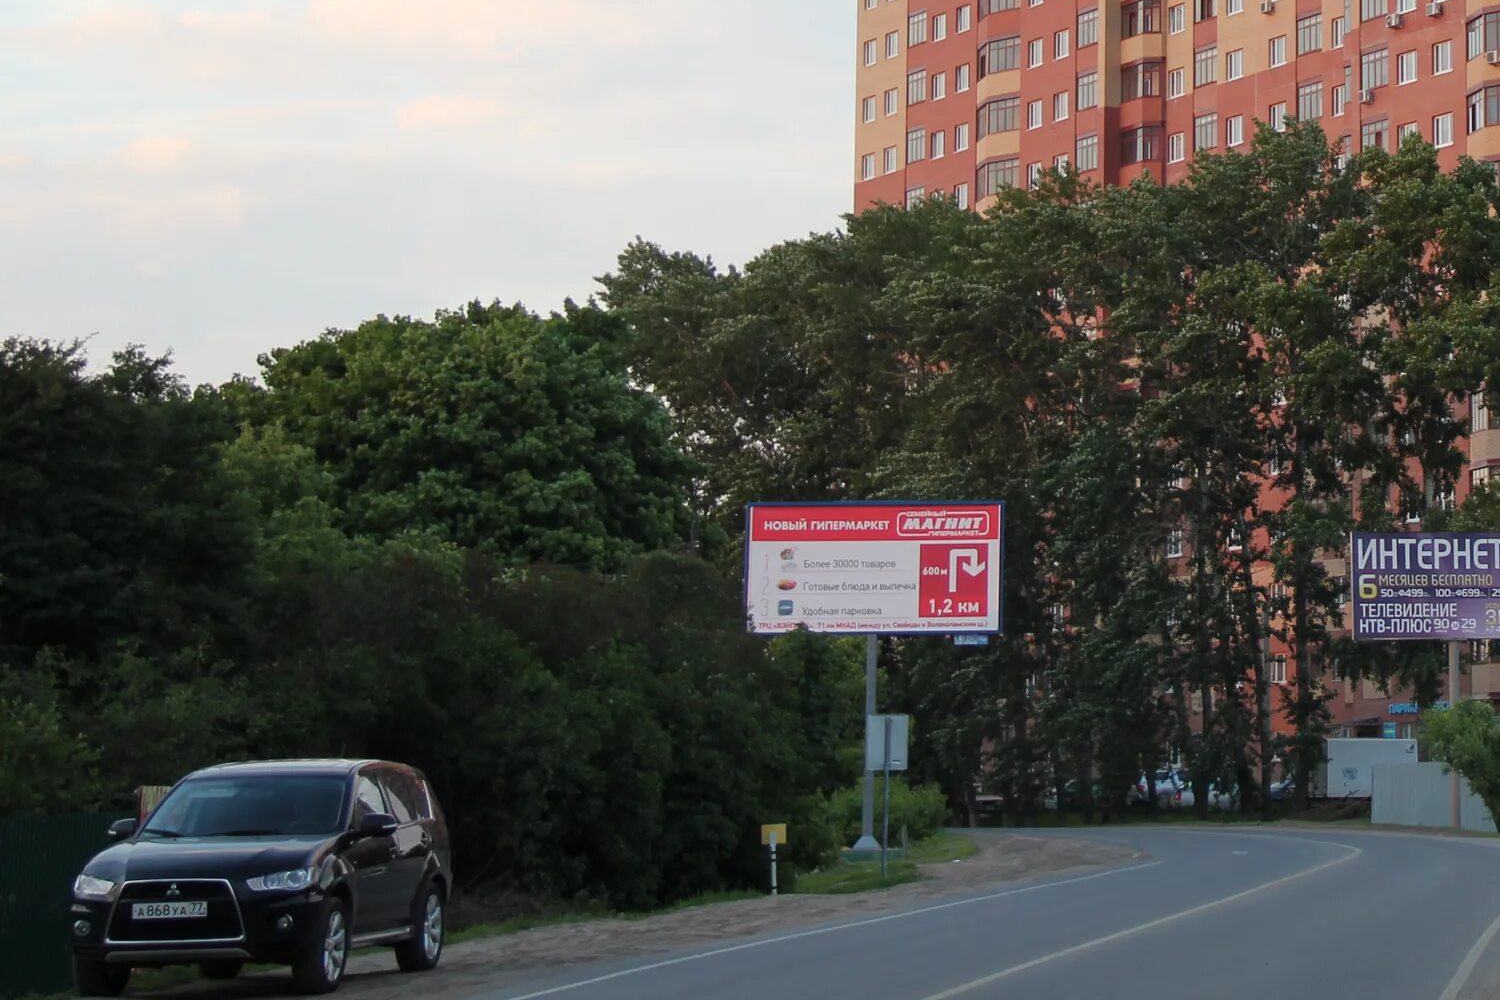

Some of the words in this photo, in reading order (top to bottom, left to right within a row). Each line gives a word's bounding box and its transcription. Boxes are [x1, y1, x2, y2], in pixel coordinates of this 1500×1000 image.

[764, 518, 807, 531] НОВЫЙ
[811, 520, 890, 531] ГИПЕРМАРКЕТ
[903, 517, 983, 530] МАГНИТ
[803, 559, 831, 569] Более
[833, 559, 859, 569] 30000
[861, 561, 896, 570] товаров
[760, 576, 770, 595] 2
[803, 582, 840, 591] Готовые
[841, 581, 870, 592] блюда
[872, 583, 878, 591] и
[880, 582, 917, 591] выпечка
[1358, 573, 1378, 600] 6
[1379, 574, 1428, 587] МЕСЯЦЕВ
[1431, 574, 1493, 586] БЕСПЛАТНО
[1380, 589, 1394, 598] 50
[1403, 588, 1424, 598] 499
[1435, 588, 1451, 598] 100
[1461, 588, 1480, 598] 699
[760, 598, 769, 617] 3
[802, 607, 839, 617] Удобная
[841, 608, 882, 617] парковка
[928, 598, 953, 617] 1,2
[958, 602, 980, 613] км
[1360, 603, 1457, 618] ТЕЛЕВИДЕНИЕ
[1359, 618, 1432, 633] НТВ-ПЛЮС
[1434, 618, 1450, 630] 90
[1460, 618, 1477, 629] 29
[191, 902, 203, 912] 77
